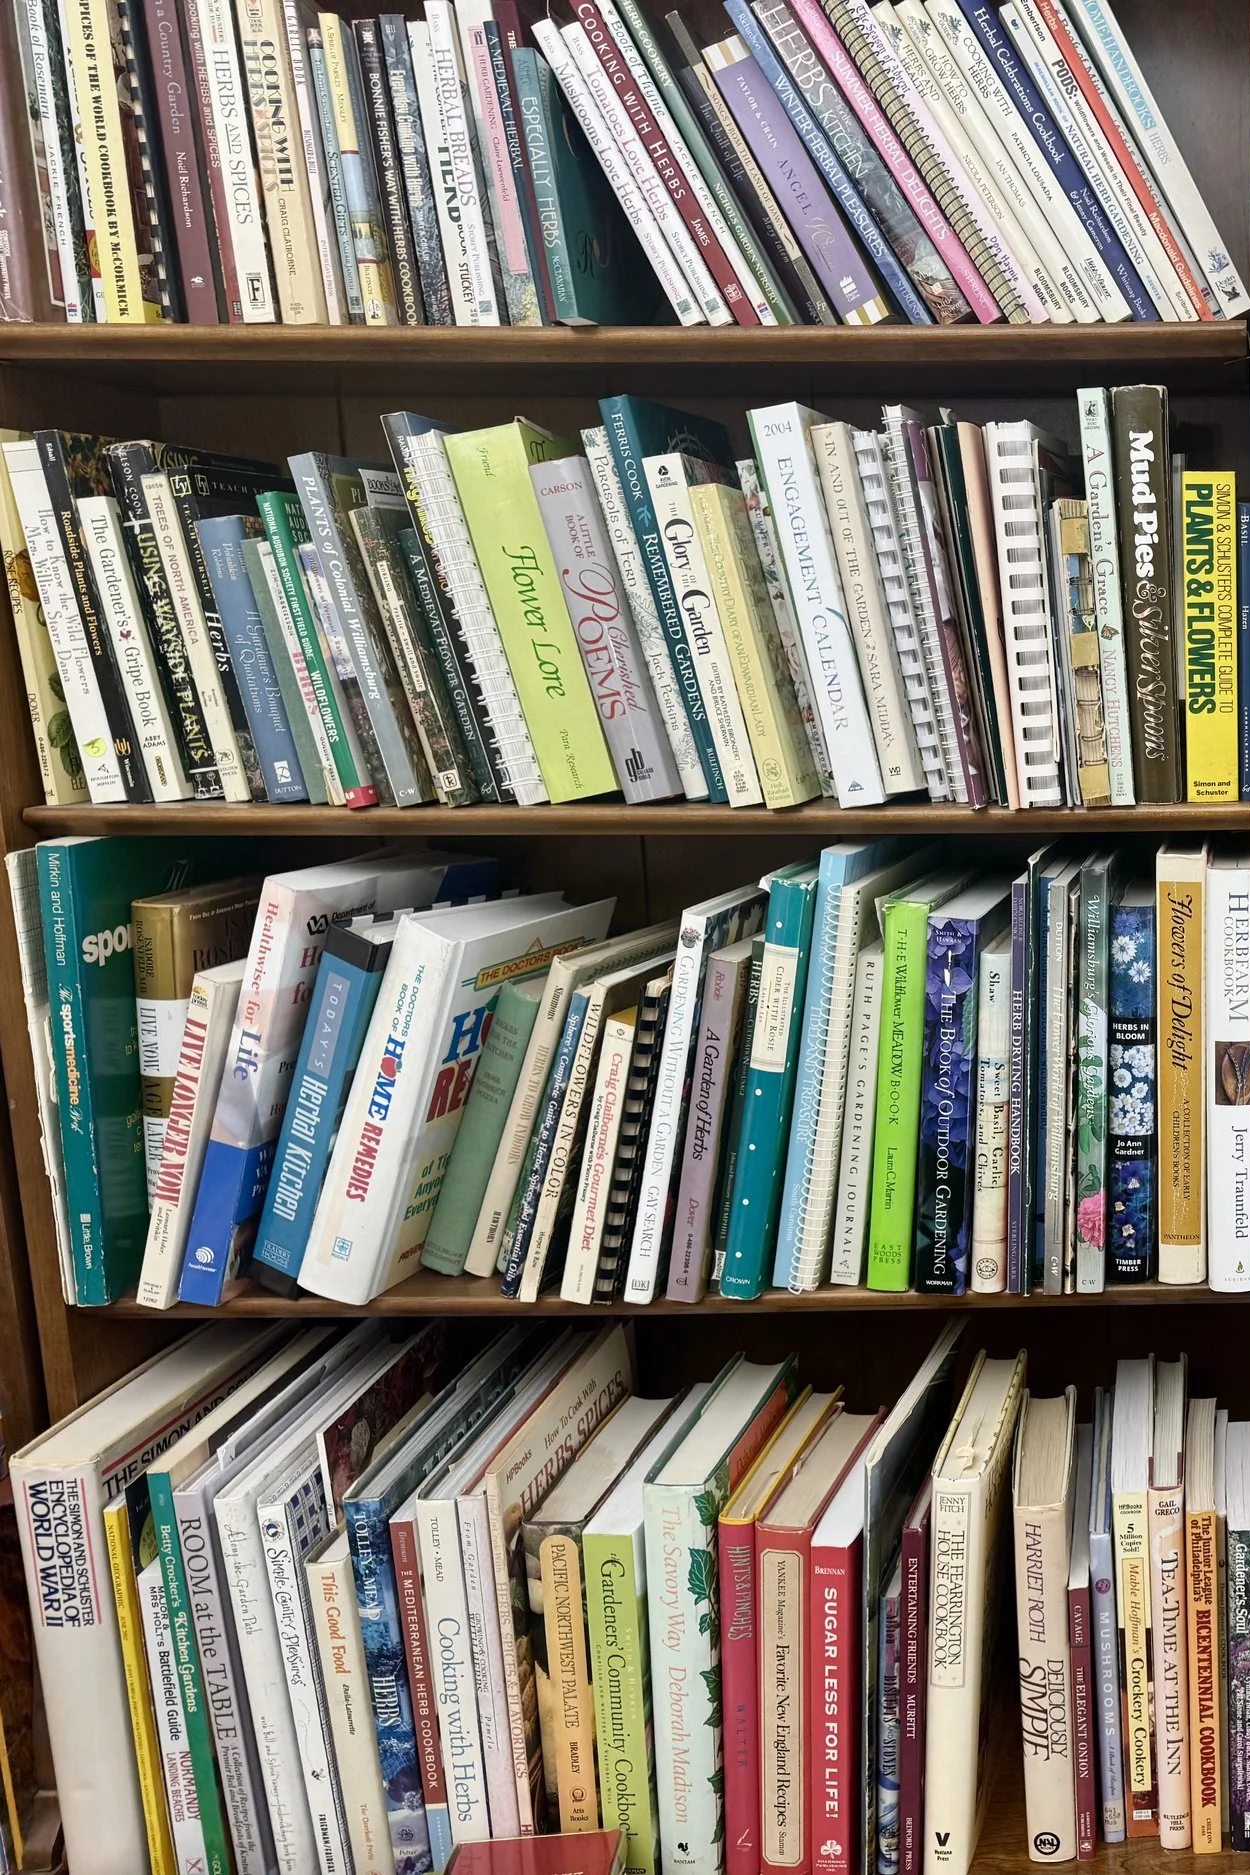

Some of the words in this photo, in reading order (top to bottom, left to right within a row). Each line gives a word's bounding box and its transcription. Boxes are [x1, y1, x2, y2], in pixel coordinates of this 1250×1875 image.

[213, 49, 238, 118] HERBS
[577, 2, 622, 85] COOKING
[623, 91, 652, 136] WITH
[649, 141, 686, 200] HERBS
[973, 7, 1002, 48] Herbal
[997, 48, 1034, 113] Celebrations
[1032, 112, 1065, 165] Cookbook
[1051, 58, 1079, 100] PODS:
[227, 122, 242, 153] AND
[1012, 132, 1034, 170] PATRICIA
[228, 156, 254, 225] SPICES
[524, 96, 552, 188] ESPECIALLY
[538, 197, 561, 249] HERBS
[777, 158, 809, 216] ANGEL
[691, 218, 711, 247] JAMES
[1149, 211, 1178, 262] Macdonald
[1174, 262, 1201, 309] Guidelines
[763, 419, 793, 437] 2004
[540, 481, 584, 497] CARSON
[1128, 430, 1158, 506] Mud
[90, 515, 108, 544] The
[1133, 513, 1160, 580] Pies
[1185, 483, 1213, 577] PLANTS
[96, 548, 129, 631] Gardener's
[777, 456, 823, 606] ENGAGEMENT
[810, 614, 849, 733] CALENDAR
[1186, 580, 1213, 599] &
[501, 545, 549, 634] Flower
[531, 637, 567, 701] Lore
[642, 532, 684, 641] REMEMBERED
[674, 642, 707, 722] GARDENS
[1241, 605, 1250, 631] Hazen
[123, 646, 143, 686] Gripe
[1187, 605, 1216, 715] FLOWERS
[134, 689, 154, 729] Book
[309, 669, 340, 743] WILDFLOWERS
[1193, 780, 1215, 788] Simon
[1196, 789, 1229, 797] Schuster
[47, 852, 61, 887] Mirkin
[51, 890, 63, 914] and
[53, 917, 67, 966] Hoffman
[1223, 916, 1235, 998] COOKBOOK
[1227, 892, 1250, 1023] HERBFARM
[989, 970, 1000, 1004] Shaw
[1112, 1023, 1137, 1031] HERBS
[1139, 1023, 1149, 1031] IN
[1115, 1032, 1145, 1041] BLOOM
[565, 1002, 602, 1119] WILDFLOWERS
[559, 1122, 572, 1140] IN
[1114, 1148, 1144, 1156] Gardner
[1117, 1140, 1127, 1148] Jo
[1231, 1125, 1248, 1163] Jerry
[545, 1144, 569, 1199] COLOR
[1233, 1169, 1248, 1239] Traunfeld
[725, 1275, 751, 1285] CROWN
[1115, 1258, 1142, 1266] TIMBER
[67, 1478, 79, 1501] THE
[28, 1480, 60, 1559] WORLD
[71, 1504, 83, 1537] SIMON
[49, 1480, 77, 1607] ENCYCLOPEDIA
[67, 1608, 82, 1627] OF
[75, 1539, 86, 1564] AND
[180, 1517, 206, 1600] ROOM
[42, 1561, 63, 1610] WAR
[78, 1566, 95, 1626] SCHUSTER
[49, 1611, 65, 1629] II
[192, 1603, 208, 1627] at
[823, 1587, 839, 1658] SUGAR
[200, 1628, 218, 1659] the
[437, 1617, 462, 1705] Cooking
[1196, 1609, 1214, 1724] BICENTENNIAL
[825, 1665, 839, 1715] LESS
[1099, 1612, 1115, 1738] MUSHROOMS
[207, 1663, 238, 1741] TABLE
[446, 1710, 467, 1748] with
[452, 1750, 474, 1823] Herbs
[1199, 1725, 1218, 1808] COOKBOOK
[825, 1768, 839, 1820] LIFE!
